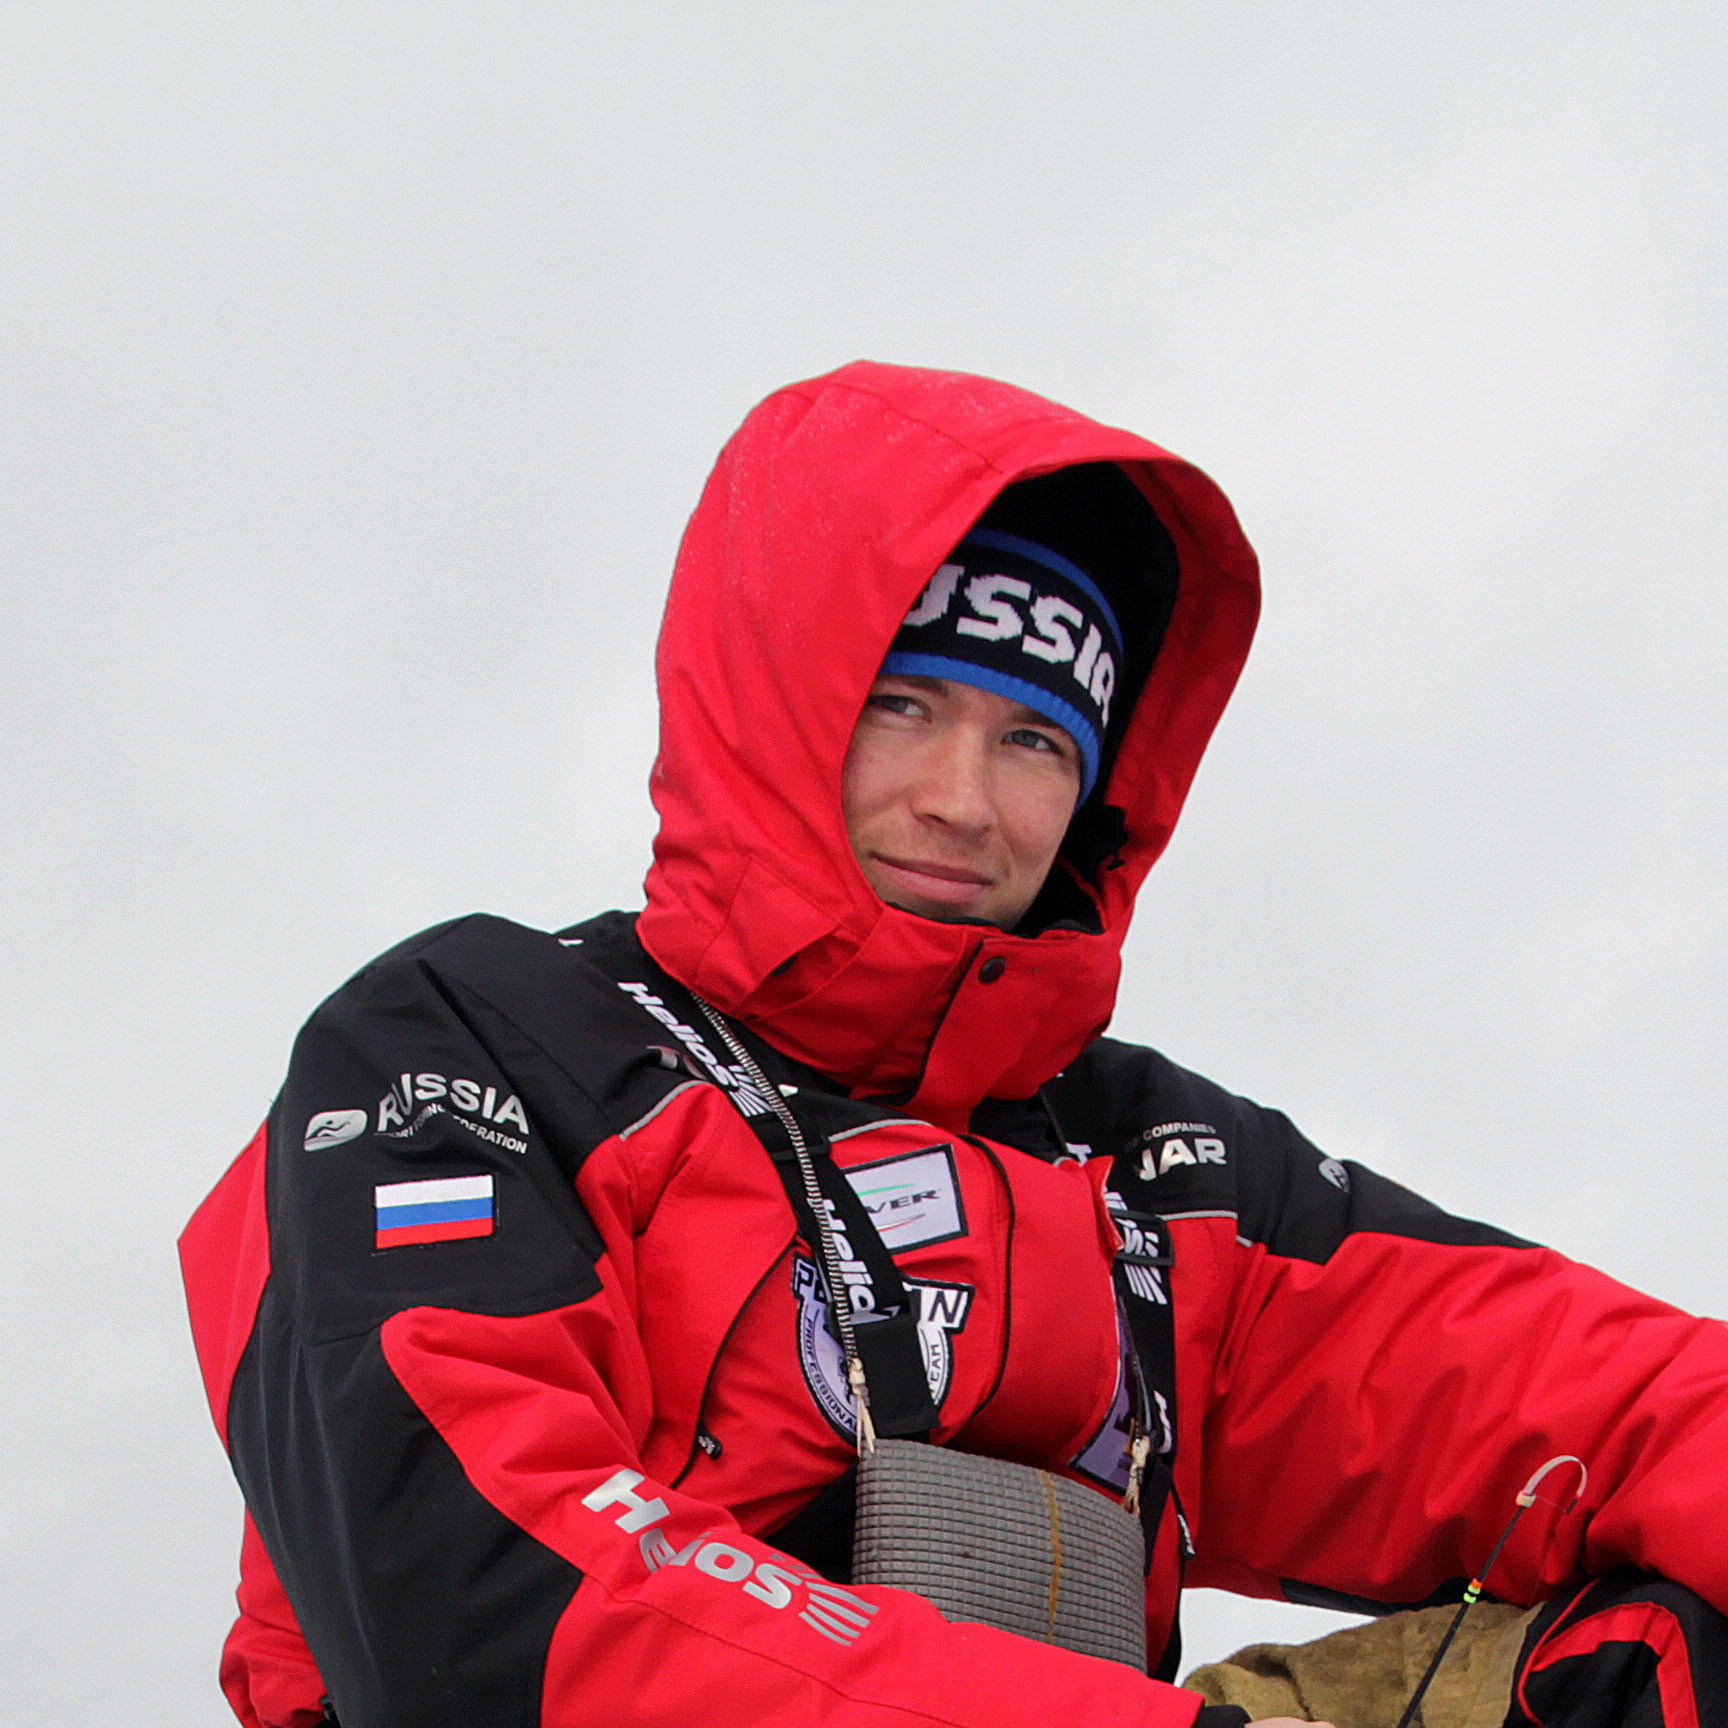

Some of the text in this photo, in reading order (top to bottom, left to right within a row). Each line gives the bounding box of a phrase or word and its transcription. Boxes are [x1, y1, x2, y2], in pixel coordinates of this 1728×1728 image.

[377, 1073, 530, 1135] RUSSIA
[807, 1197, 901, 1325] Helio
[802, 1317, 858, 1435] PROFESSIONA
